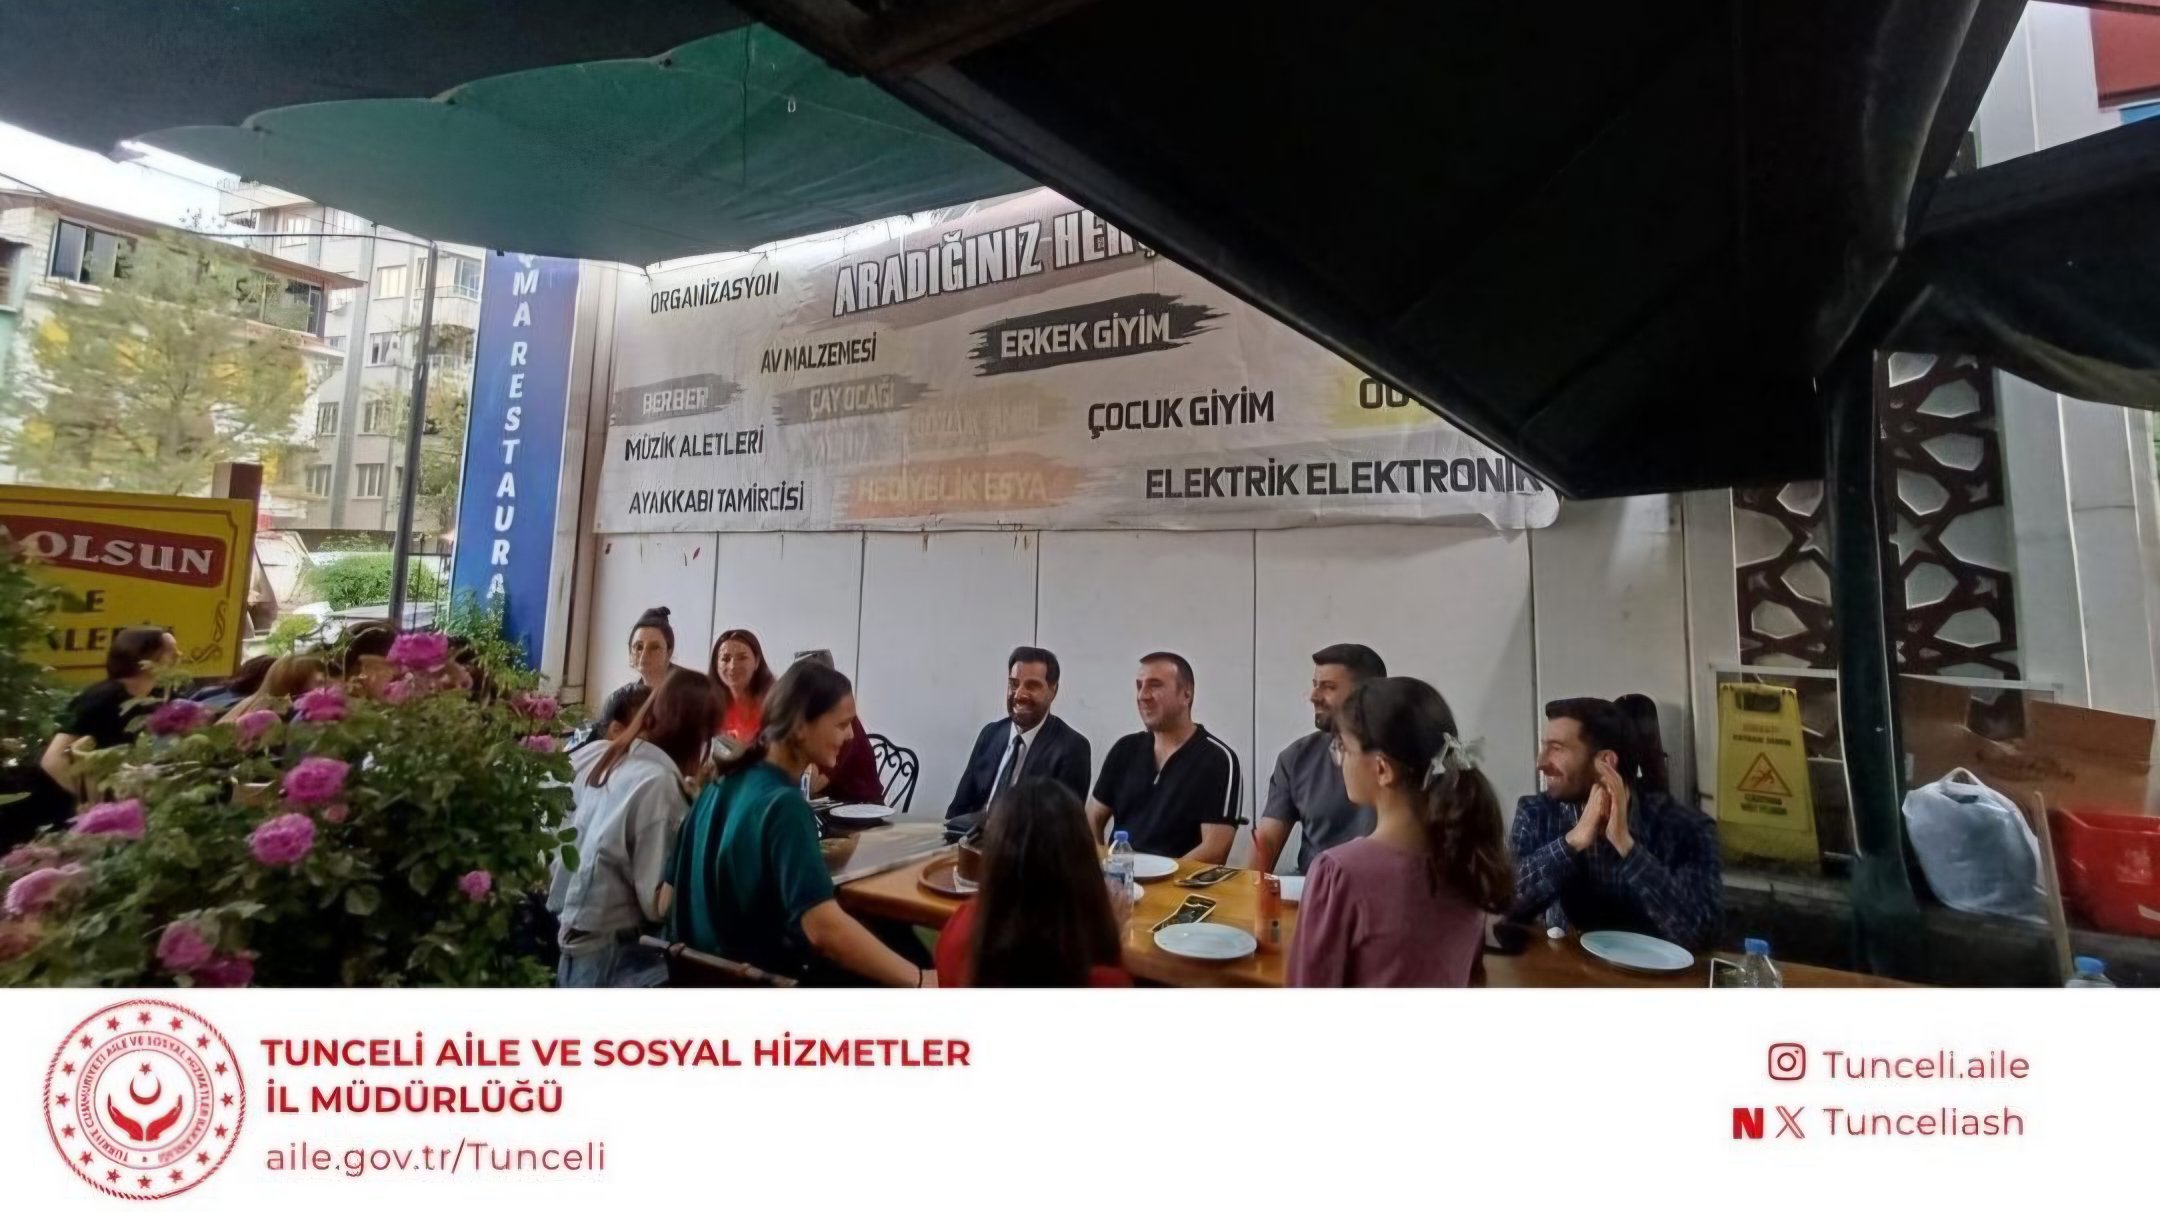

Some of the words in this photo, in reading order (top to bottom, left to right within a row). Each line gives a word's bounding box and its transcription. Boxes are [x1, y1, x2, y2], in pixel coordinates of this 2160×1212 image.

[833, 220, 1043, 317] ARADIĞINIZ
[651, 271, 779, 314] ORGANİZASYON
[761, 348, 783, 374] AV
[784, 331, 877, 372] MALZEMESİ
[1001, 321, 1088, 358] ERKEK
[1094, 308, 1170, 349] GİYİM
[642, 386, 708, 415] BERBER
[810, 383, 841, 419] ÇAY
[844, 375, 895, 410] OCAĞI
[1088, 398, 1183, 440] ÇOCUK
[1189, 386, 1274, 426] GİYİM
[625, 431, 674, 461] MÜZİK
[679, 425, 764, 457] ALETLERİ
[486, 341, 527, 600] RESTAURA
[1146, 457, 1300, 499] ELEKTRİK
[629, 489, 713, 514] AYAKKABI
[718, 481, 804, 513] TAMİRCİSİ
[20, 531, 214, 575] OLSUN
